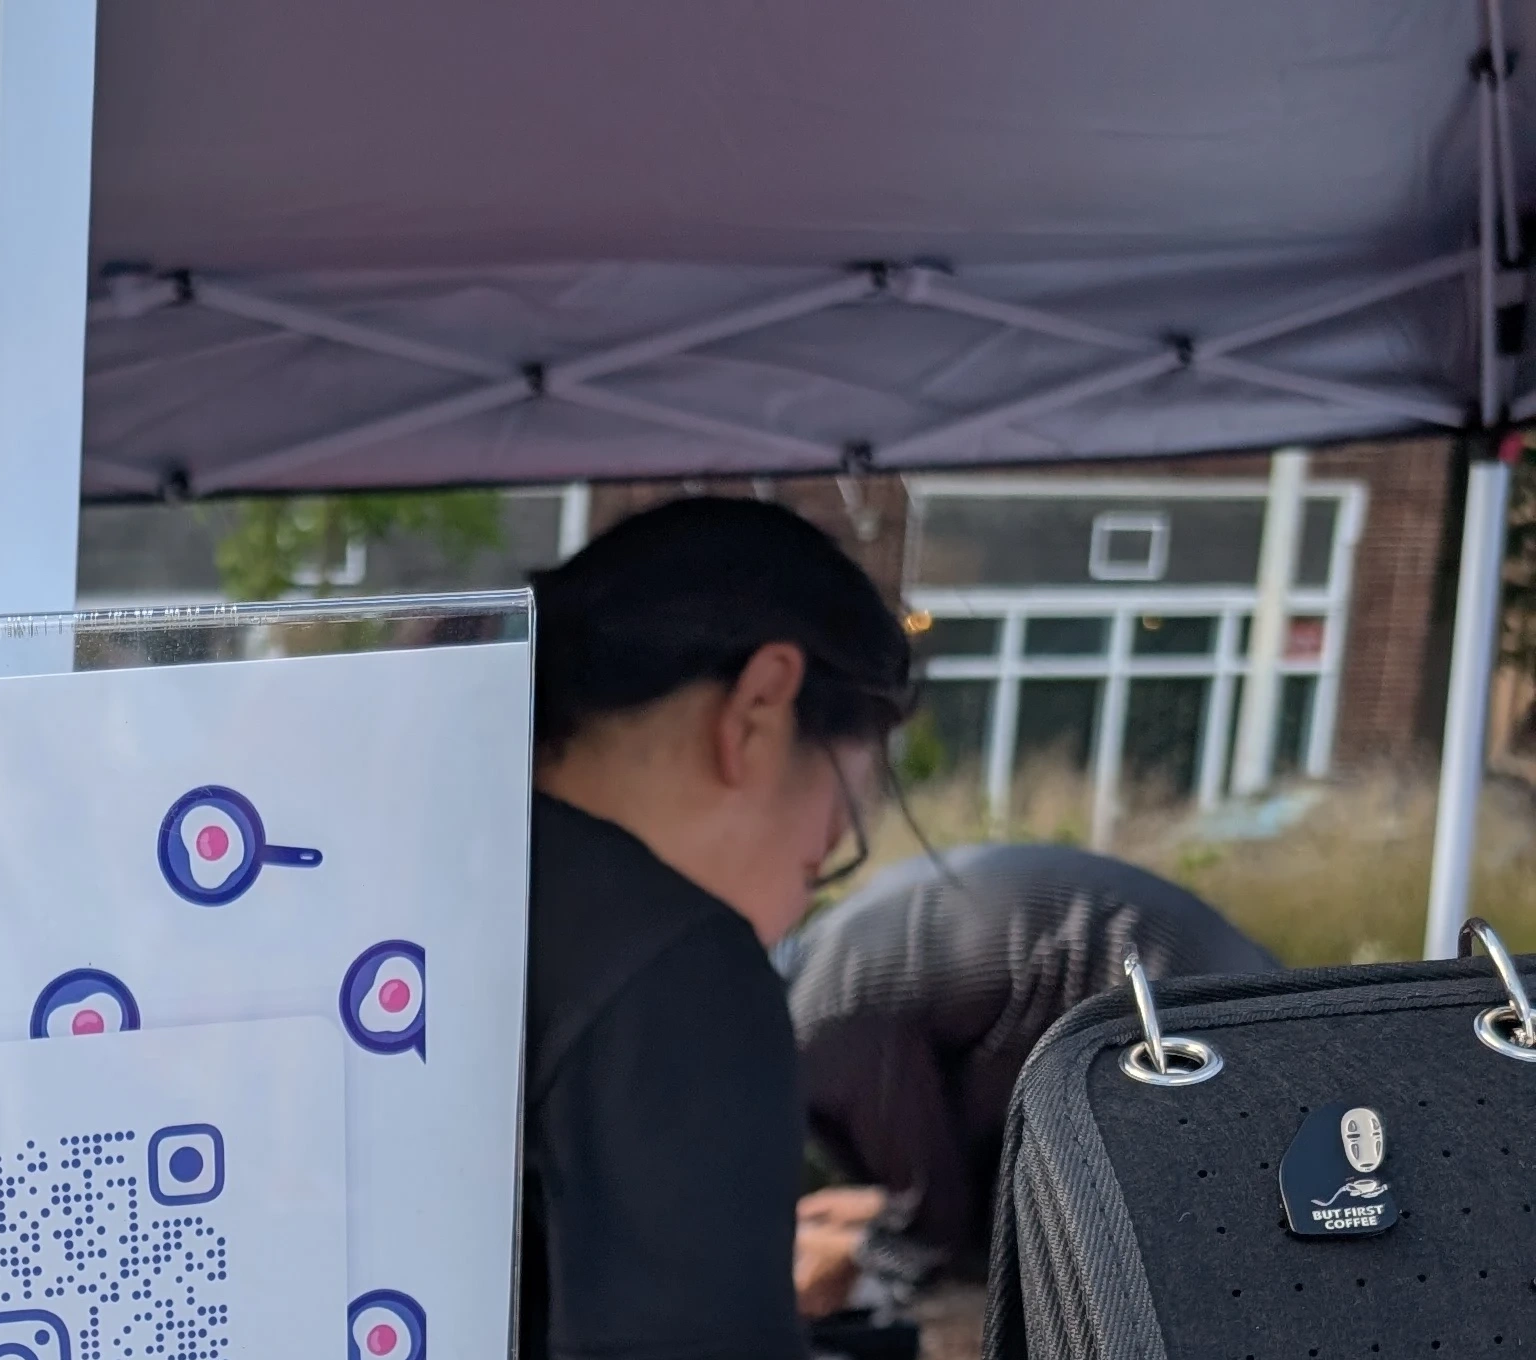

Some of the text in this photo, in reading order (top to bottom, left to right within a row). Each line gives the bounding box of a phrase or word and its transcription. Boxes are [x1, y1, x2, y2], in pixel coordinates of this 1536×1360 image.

[1312, 1204, 1385, 1221] BUT FIRST
[1324, 1216, 1378, 1230] COFFEE
